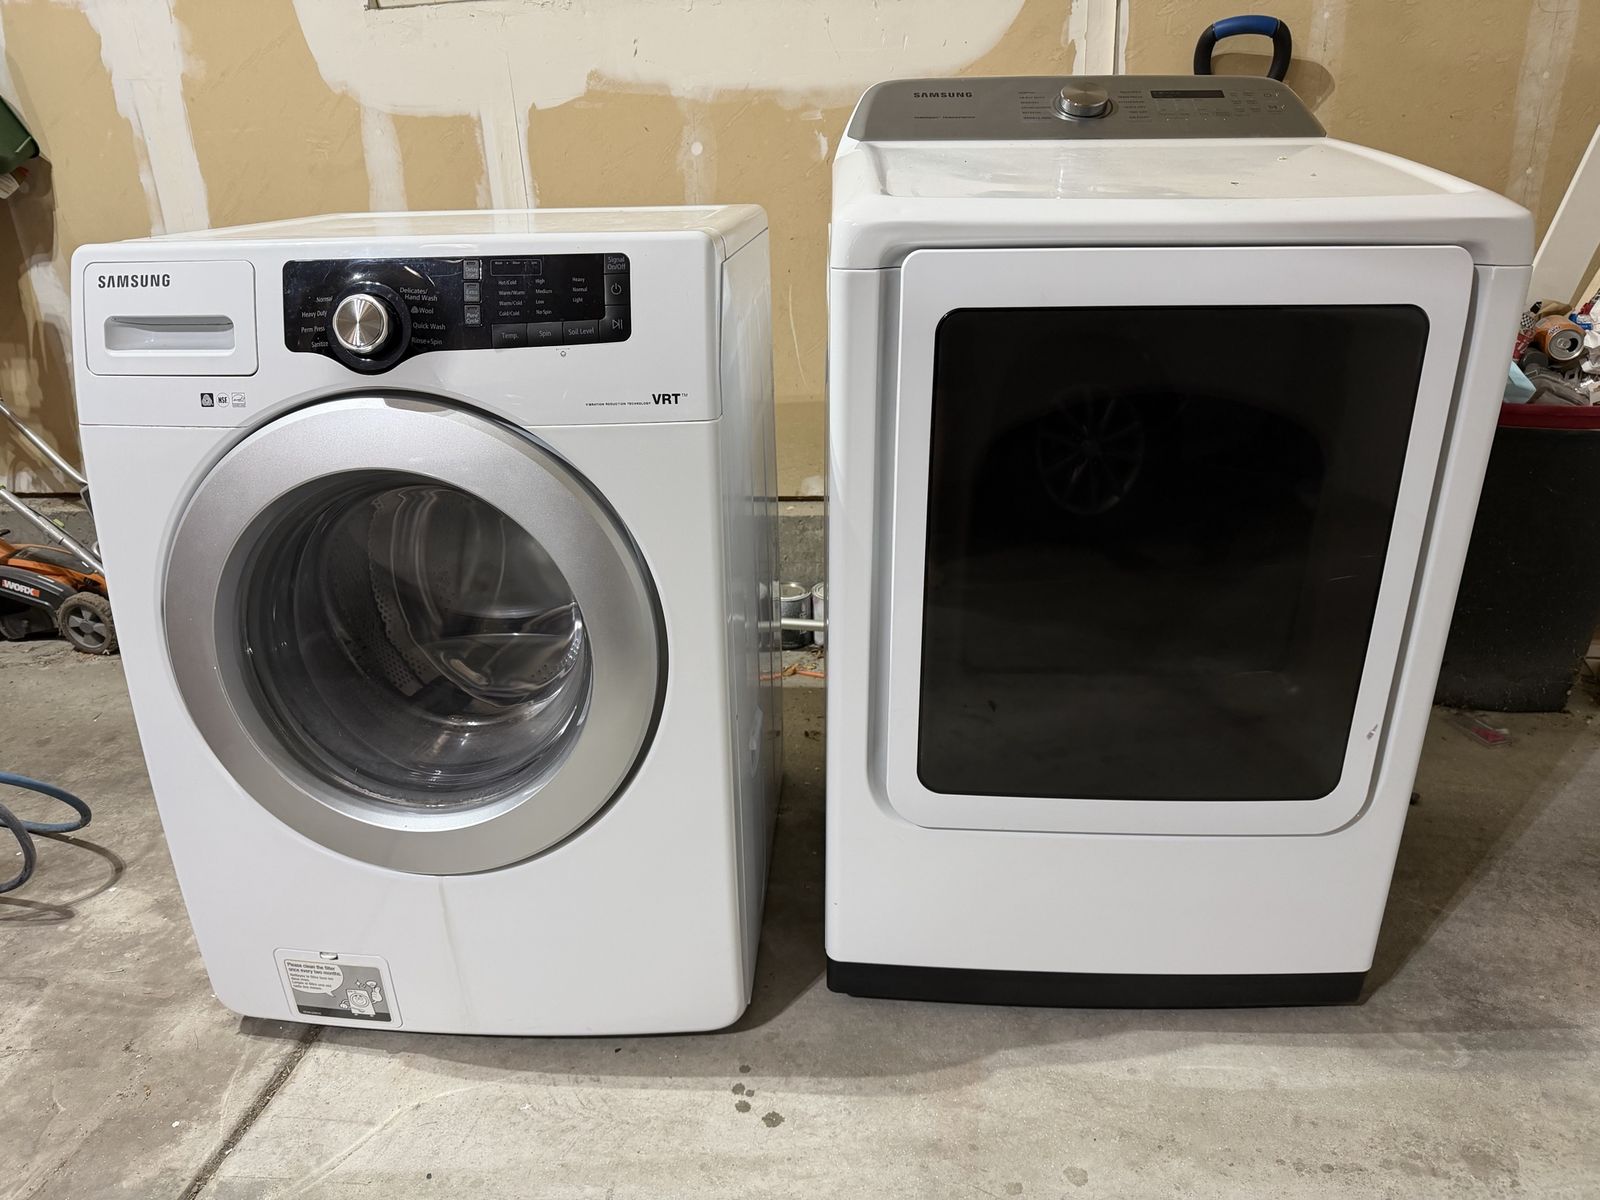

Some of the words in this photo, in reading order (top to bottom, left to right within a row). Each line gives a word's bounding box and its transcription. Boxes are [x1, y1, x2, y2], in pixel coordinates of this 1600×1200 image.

[607, 256, 625, 264] Signal
[607, 263, 626, 271] On/Off
[97, 274, 171, 288] SAMSUNG
[315, 295, 334, 303] Normal
[404, 293, 421, 301] Hand
[301, 311, 317, 319] Heavy
[316, 309, 328, 318] Duty
[419, 307, 434, 315] Wool
[314, 325, 326, 333] Press
[412, 321, 429, 330] Quick
[430, 323, 446, 331] Wash
[538, 330, 552, 338] Spin
[568, 328, 580, 336] Soil
[580, 327, 595, 335] Level
[501, 332, 519, 340] Temp.
